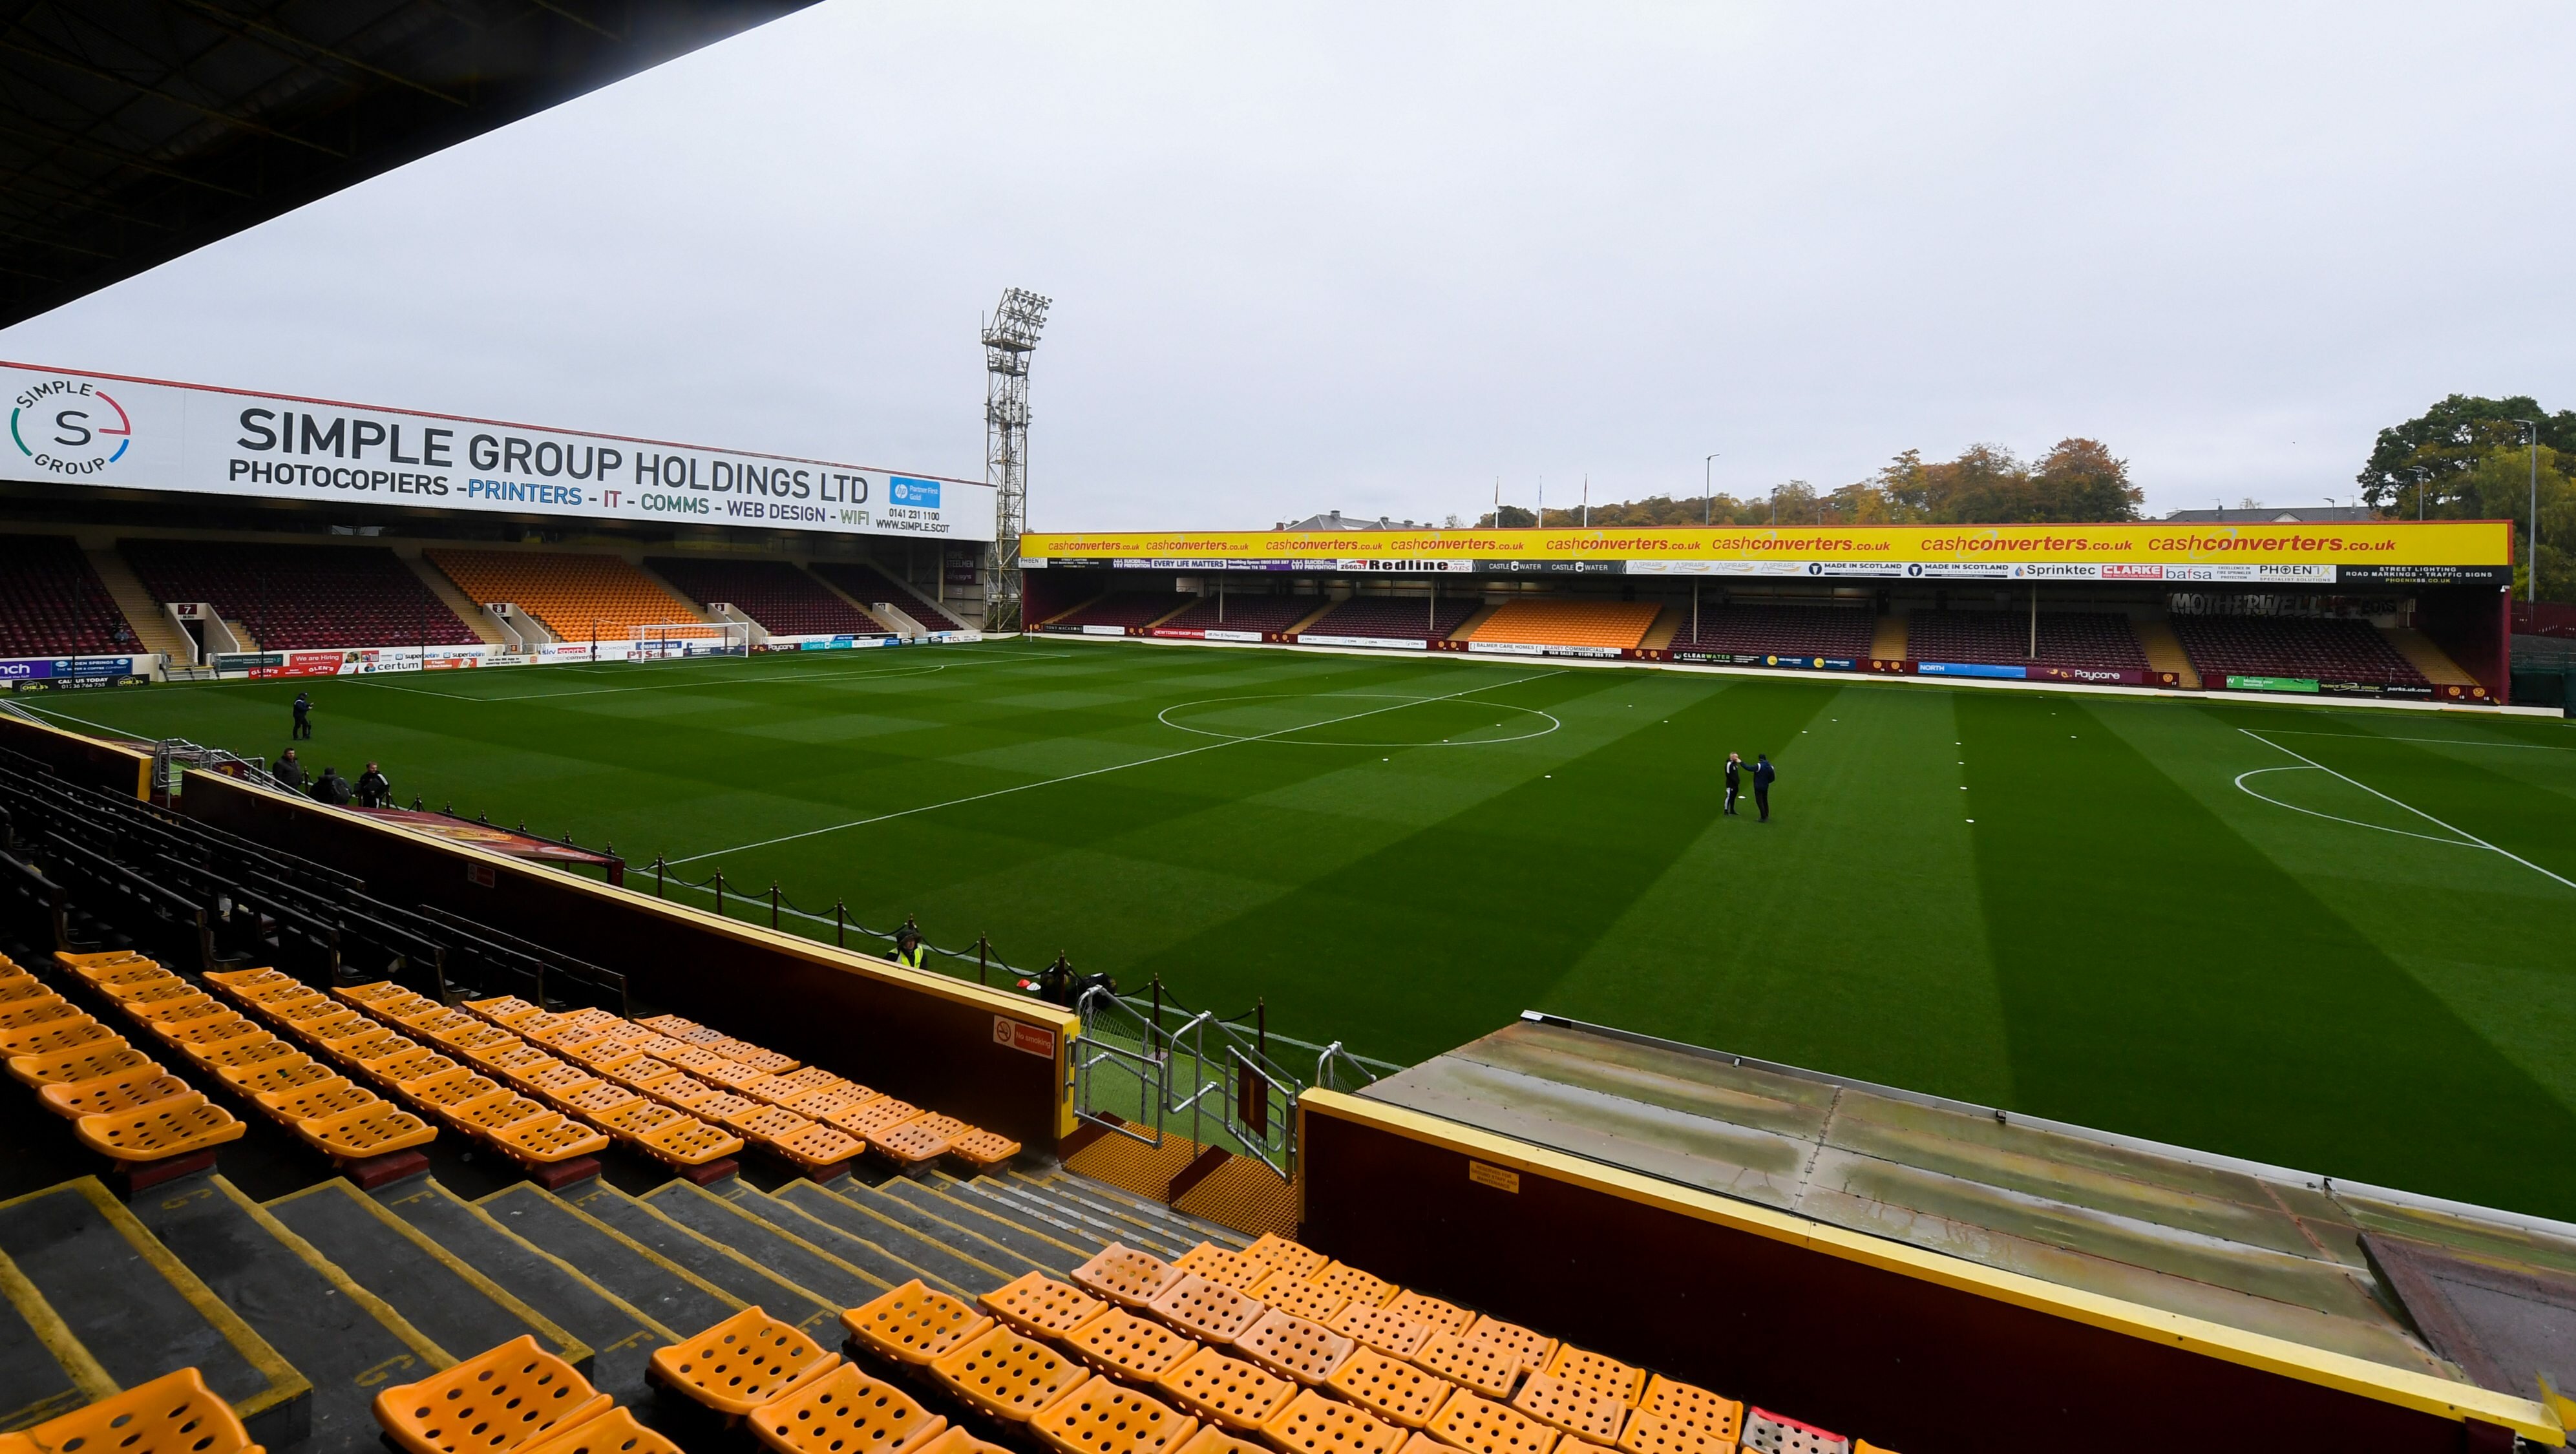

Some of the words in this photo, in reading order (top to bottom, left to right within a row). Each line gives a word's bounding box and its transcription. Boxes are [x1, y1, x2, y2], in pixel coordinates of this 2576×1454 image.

[16, 381, 93, 408] SIMPLE
[54, 410, 91, 446] S
[237, 408, 454, 468] SIMPLE
[469, 434, 622, 481] GROUP
[635, 452, 810, 500] HOLDINGS
[821, 473, 869, 504] LTD
[34, 454, 105, 474] GROUP
[229, 459, 449, 496] PHOTOCOPIERS
[604, 490, 622, 509] IT
[641, 493, 710, 514] COMMS
[727, 500, 765, 518] WEB
[769, 504, 826, 523] DESIGN
[840, 509, 870, 525] WIFI
[889, 509, 906, 518] 0141
[909, 510, 920, 519] 231
[924, 511, 940, 521] 1100
[1048, 540, 1139, 551] cashconverters.co.uk
[1146, 540, 1249, 551] cashconverters.co.uk
[1266, 539, 1382, 550] cashconverters.co.uk
[1391, 538, 1524, 550] cashconverters.co.uk
[1547, 537, 1701, 550] cashconverters.co.uk
[1713, 536, 1890, 550] cashconverters.co.uk
[1921, 536, 2133, 551] cashconverters.co.uk
[2148, 535, 2396, 551] cashconverters.co.uk
[1369, 560, 1448, 571] Redline
[2027, 565, 2096, 577] Sprinktec
[2103, 566, 2161, 574] CLARKE
[2166, 567, 2212, 580] bafsa
[2170, 593, 2320, 616] MOTHERWELL
[378, 662, 419, 670] certum
[2075, 669, 2120, 680] Paycare
[1015, 1031, 1024, 1040] No
[1024, 1035, 1051, 1049] smoking
[1476, 1164, 1501, 1175] RESERVED
[1477, 1175, 1510, 1189] MAINTENANCE
[390, 1190, 436, 1206] F
[604, 1330, 654, 1353] F
